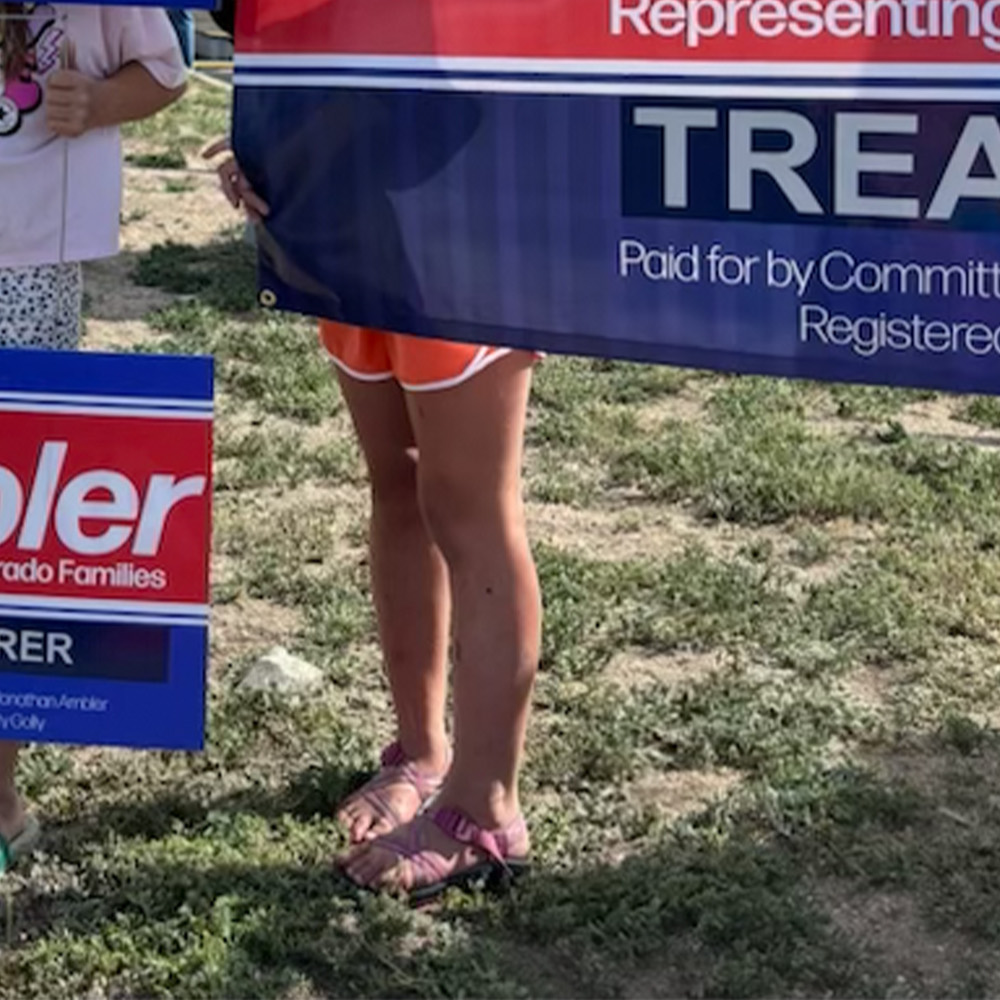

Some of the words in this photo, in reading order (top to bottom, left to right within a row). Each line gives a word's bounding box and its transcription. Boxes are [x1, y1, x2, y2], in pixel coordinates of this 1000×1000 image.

[619, 239, 699, 282] Paid
[706, 245, 760, 286] for
[766, 250, 815, 297] by
[800, 304, 1000, 356] Registere
[59, 560, 167, 590] Families
[58, 693, 108, 711] Ambler
